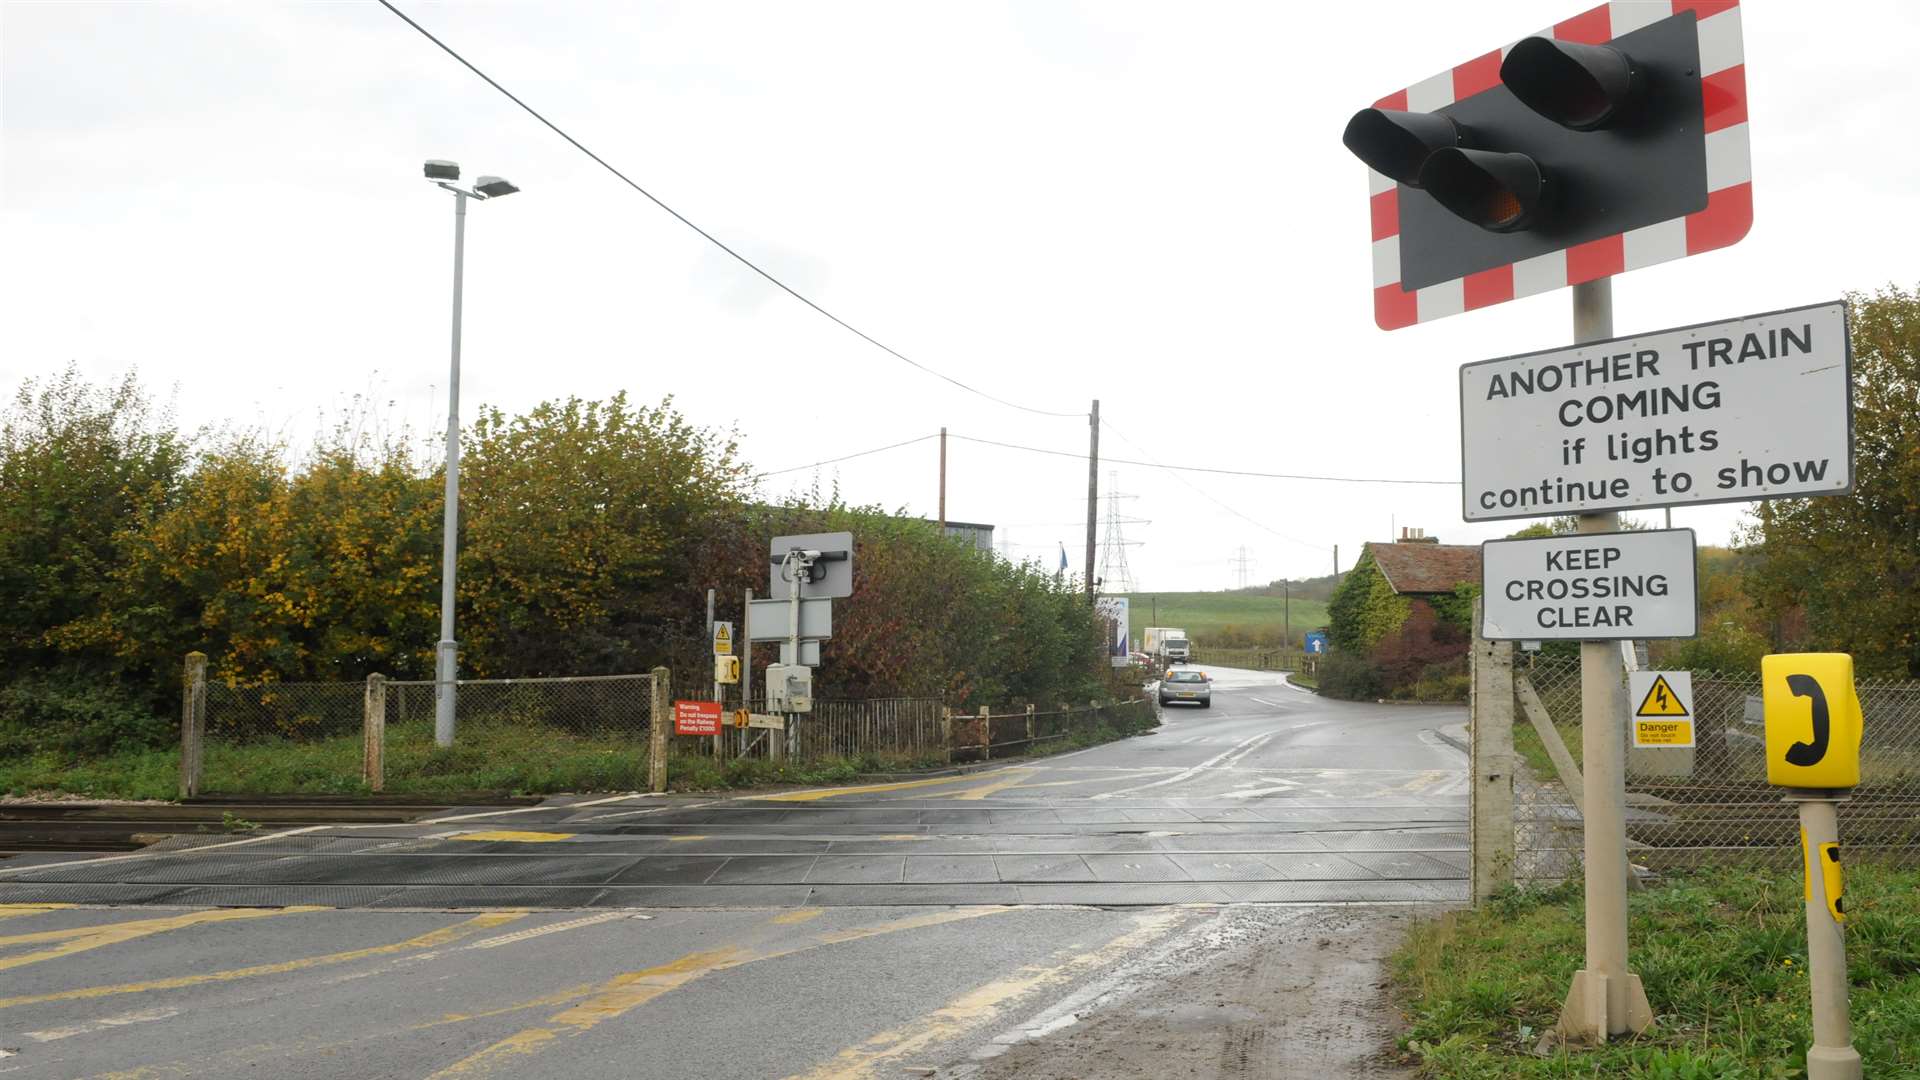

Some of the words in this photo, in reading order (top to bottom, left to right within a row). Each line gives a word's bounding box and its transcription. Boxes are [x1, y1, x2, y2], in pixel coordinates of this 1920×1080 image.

[1487, 350, 1659, 400] ANOTHER
[1682, 324, 1811, 370] TRAIN
[1559, 381, 1720, 427] COMING
[1563, 438, 1585, 465] if
[1608, 426, 1718, 463] lights
[1481, 477, 1629, 509] continue
[1652, 468, 1692, 494] to
[1717, 459, 1828, 489] show
[1547, 548, 1620, 571] KEEP
[1506, 575, 1667, 601] CROSSING
[1537, 606, 1633, 628] CLEAR
[1640, 723, 1678, 733] Danger
